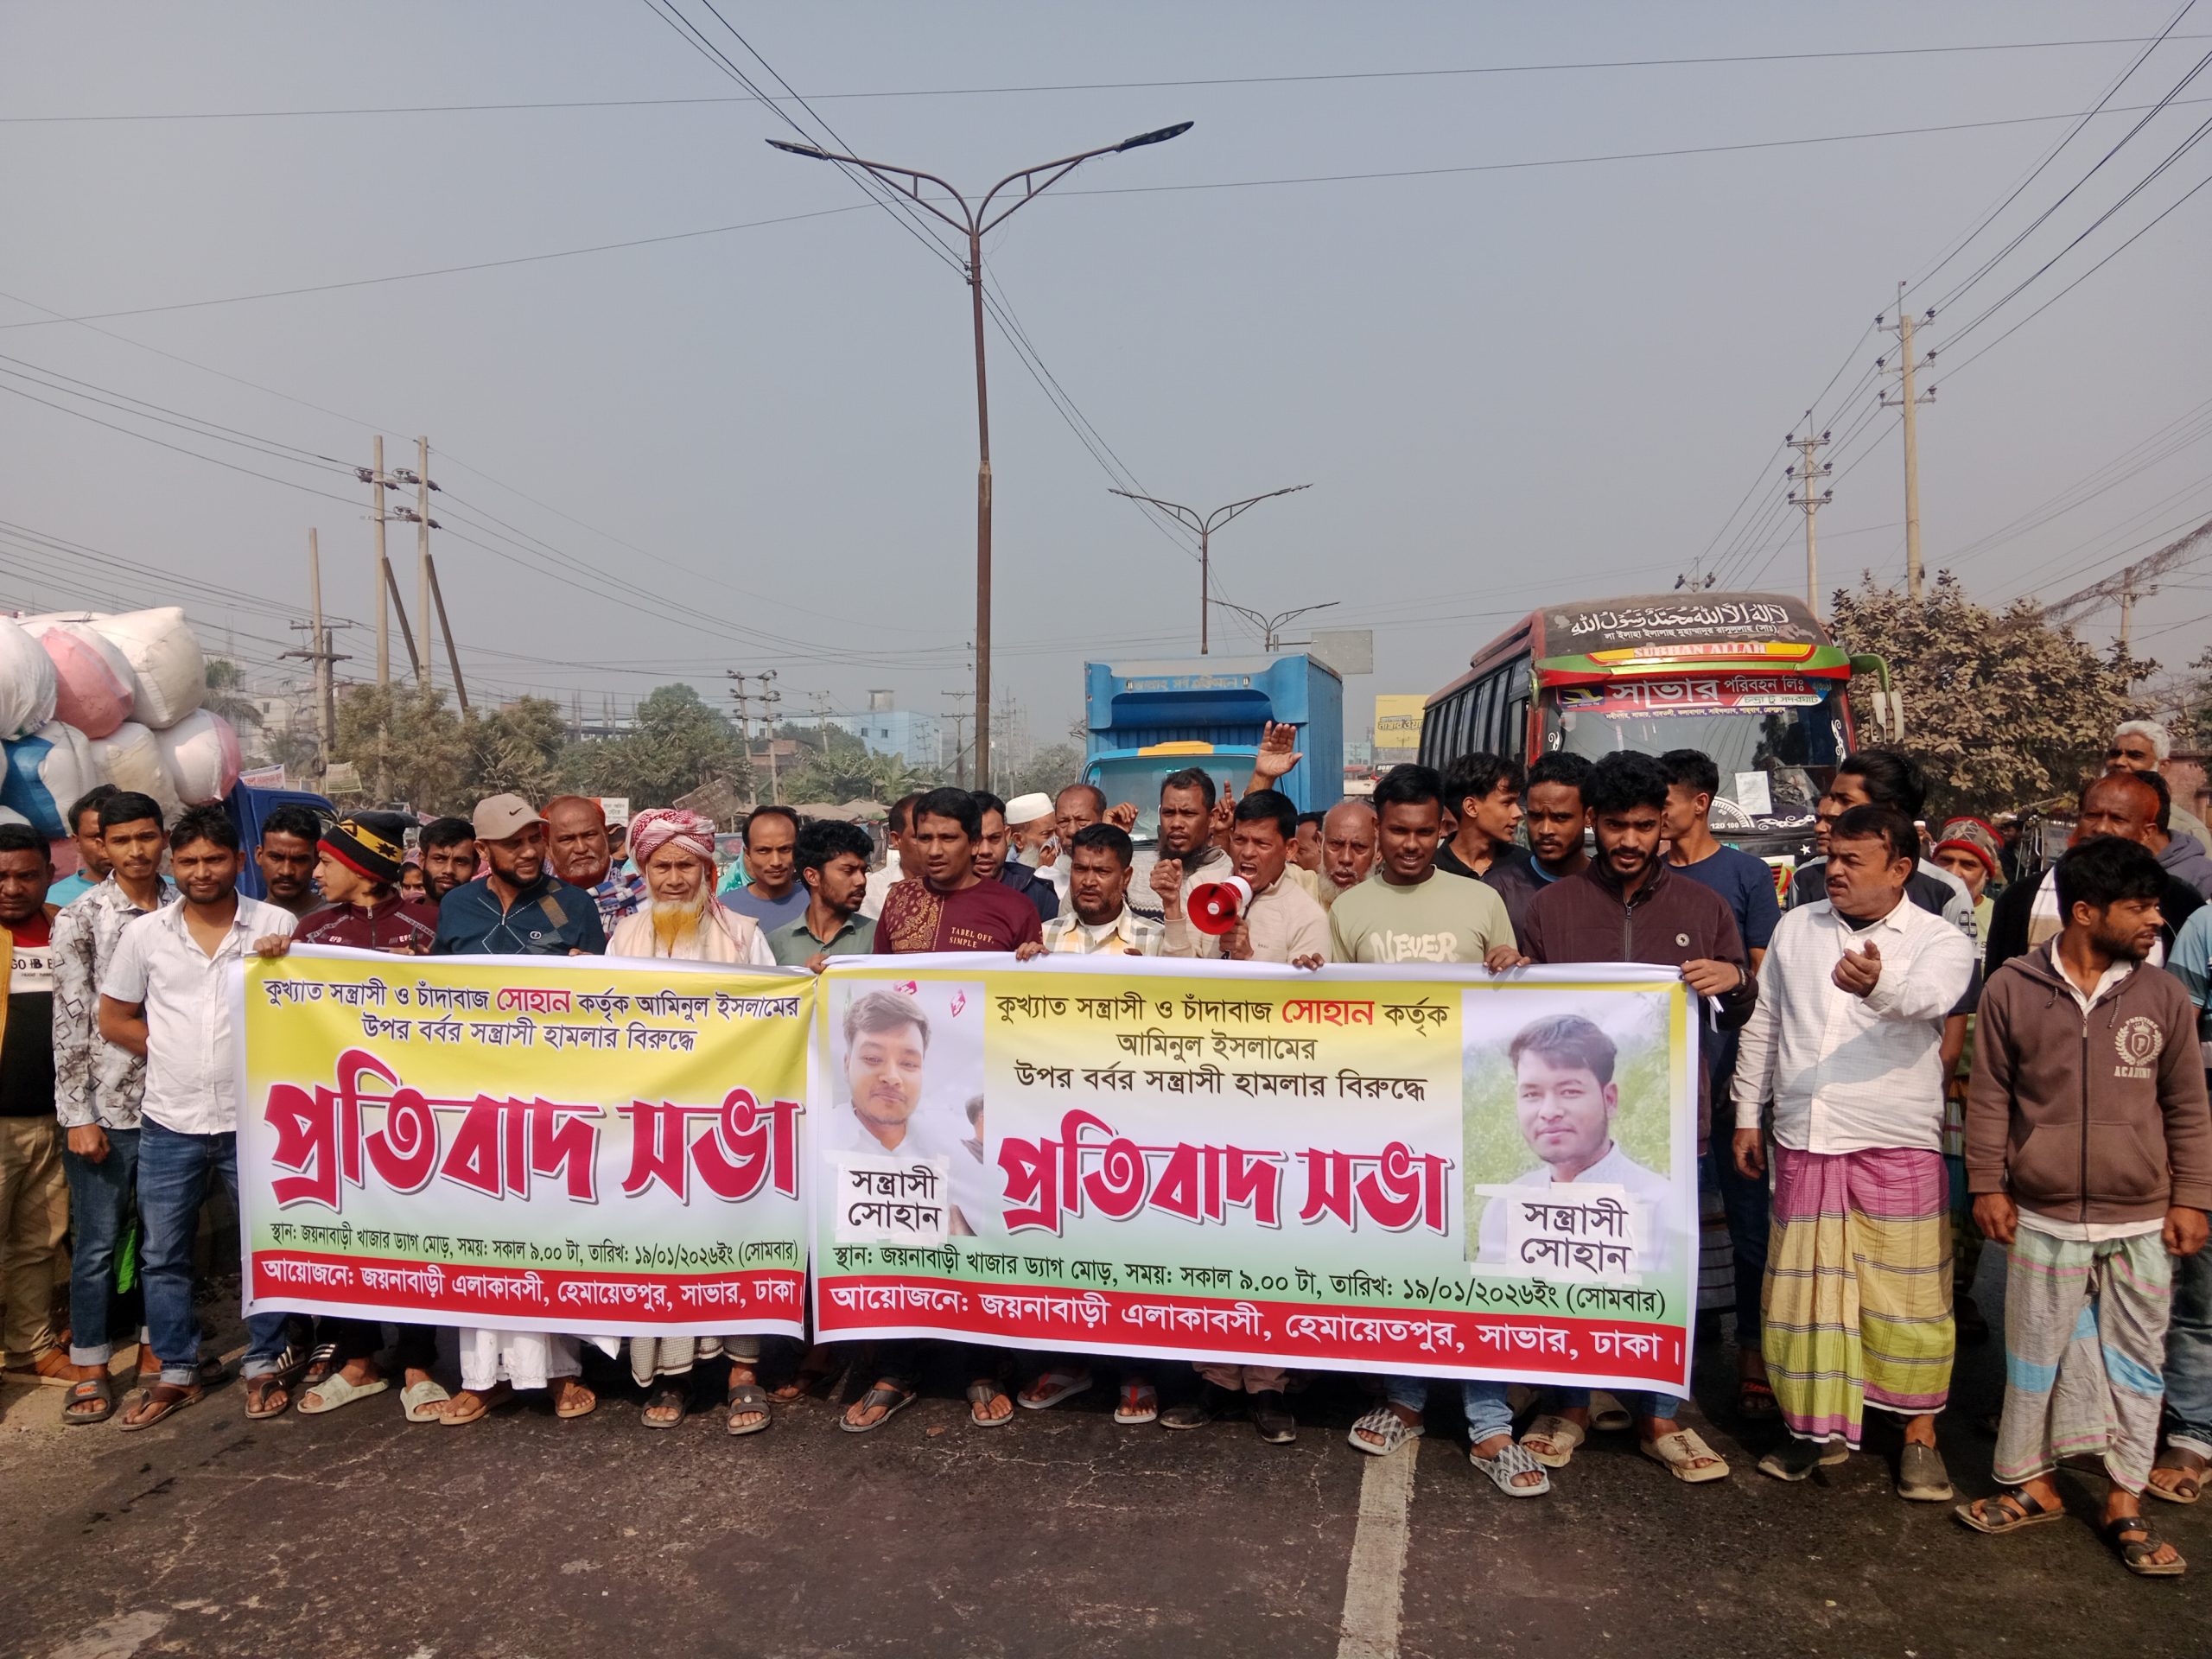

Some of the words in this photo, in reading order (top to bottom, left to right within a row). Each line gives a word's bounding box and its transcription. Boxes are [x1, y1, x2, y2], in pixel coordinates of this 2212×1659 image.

[1634, 645, 1705, 658] SUBHAN
[1710, 643, 1766, 655] ALLAH
[1607, 677, 1720, 705] সাভার
[1724, 675, 1777, 693] পরিবহন
[1782, 675, 1804, 692] লিঃ
[950, 936, 978, 949] SIMPLE
[951, 926, 975, 938] TABEL
[1370, 929, 1460, 963] NEVER
[264, 980, 323, 1008] কুখ্যাত
[329, 976, 387, 1007] সন্ত্রাসী
[396, 987, 409, 1006] ও
[416, 979, 488, 1010] চাঁদাবাজ
[496, 988, 572, 1015] সোহান
[577, 987, 629, 1027] কর্তৃক
[636, 990, 710, 1021] আমিনুল
[716, 989, 800, 1019] ইসলামের
[995, 994, 1070, 1025] কুখ্যাত
[1075, 991, 1147, 1021] সন্ত্রাসী
[1155, 1000, 1173, 1020] ও
[1181, 993, 1274, 1024] চাঁদাবাজ
[1282, 999, 1375, 1027] সোহান
[1382, 997, 1451, 1038] কর্তৃক
[361, 1012, 409, 1042] উপর
[418, 1014, 461, 1043] বর্বর
[470, 1015, 536, 1048] সন্ত্রাসী
[543, 1025, 620, 1051] হামলার
[626, 1023, 698, 1052] বিরুদ্ধে
[1116, 1027, 1205, 1064] আমিনুল
[1210, 1028, 1319, 1061] ইসলামের
[1014, 1058, 1074, 1090] উপর
[1081, 1061, 1137, 1091] বর্বর
[1143, 1064, 1225, 1094] সন্ত্রাসী
[1232, 1071, 1328, 1099] হামলার
[1335, 1068, 1428, 1102] বিরুদ্ধে
[264, 1048, 605, 1214] প্রতিবাদ
[615, 1086, 805, 1206] সভা
[849, 1165, 939, 1200] সন্ত্রাসী
[996, 1109, 1289, 1238] প্রতিবাদ
[1295, 1140, 1455, 1237] সভা
[849, 1200, 943, 1232] সোহান
[1522, 1197, 1629, 1237] সন্ত্রাসী
[270, 1221, 297, 1245] স্থান:
[302, 1221, 353, 1249] জয়নাবাড়ী
[357, 1229, 390, 1249] খাজার
[394, 1230, 418, 1251] ড্যাগ
[423, 1233, 454, 1259] মোড়,
[457, 1236, 488, 1258] সময়:
[492, 1238, 525, 1260] সকাল
[565, 1239, 584, 1264] টা,
[589, 1239, 629, 1262] তারিখ:
[738, 1239, 798, 1268] (সোমবার)
[1521, 1237, 1632, 1274] সোহান
[262, 1260, 353, 1287] আয়োজনে:
[360, 1265, 445, 1297] জয়নাবাড়ী
[451, 1273, 550, 1306] এলাকাবসী,
[557, 1279, 673, 1312] হেমায়েতপুর,
[678, 1280, 747, 1309] সাভার,
[833, 1244, 873, 1271] স্থান:
[880, 1243, 960, 1273] জয়নাবাড়ী
[967, 1251, 1019, 1274] খাজার
[1023, 1255, 1064, 1281] ড্যাগ
[1071, 1259, 1118, 1287] মোড়,
[1125, 1262, 1173, 1286] সময়:
[1180, 1265, 1231, 1290] সকাল
[1294, 1266, 1322, 1299] টা,
[1329, 1269, 1394, 1299] তারিখ:
[1566, 1282, 1667, 1320] (সোমবার)
[830, 1283, 969, 1313] আয়োজনে:
[980, 1291, 1112, 1328] জয়নাবাড়ী
[1121, 1302, 1273, 1341] এলাকাবসী,
[1286, 1312, 1465, 1353] হেমায়েতপুর,
[1476, 1322, 1578, 1360] সাভার,
[1590, 1330, 1664, 1363] ঢাকা
